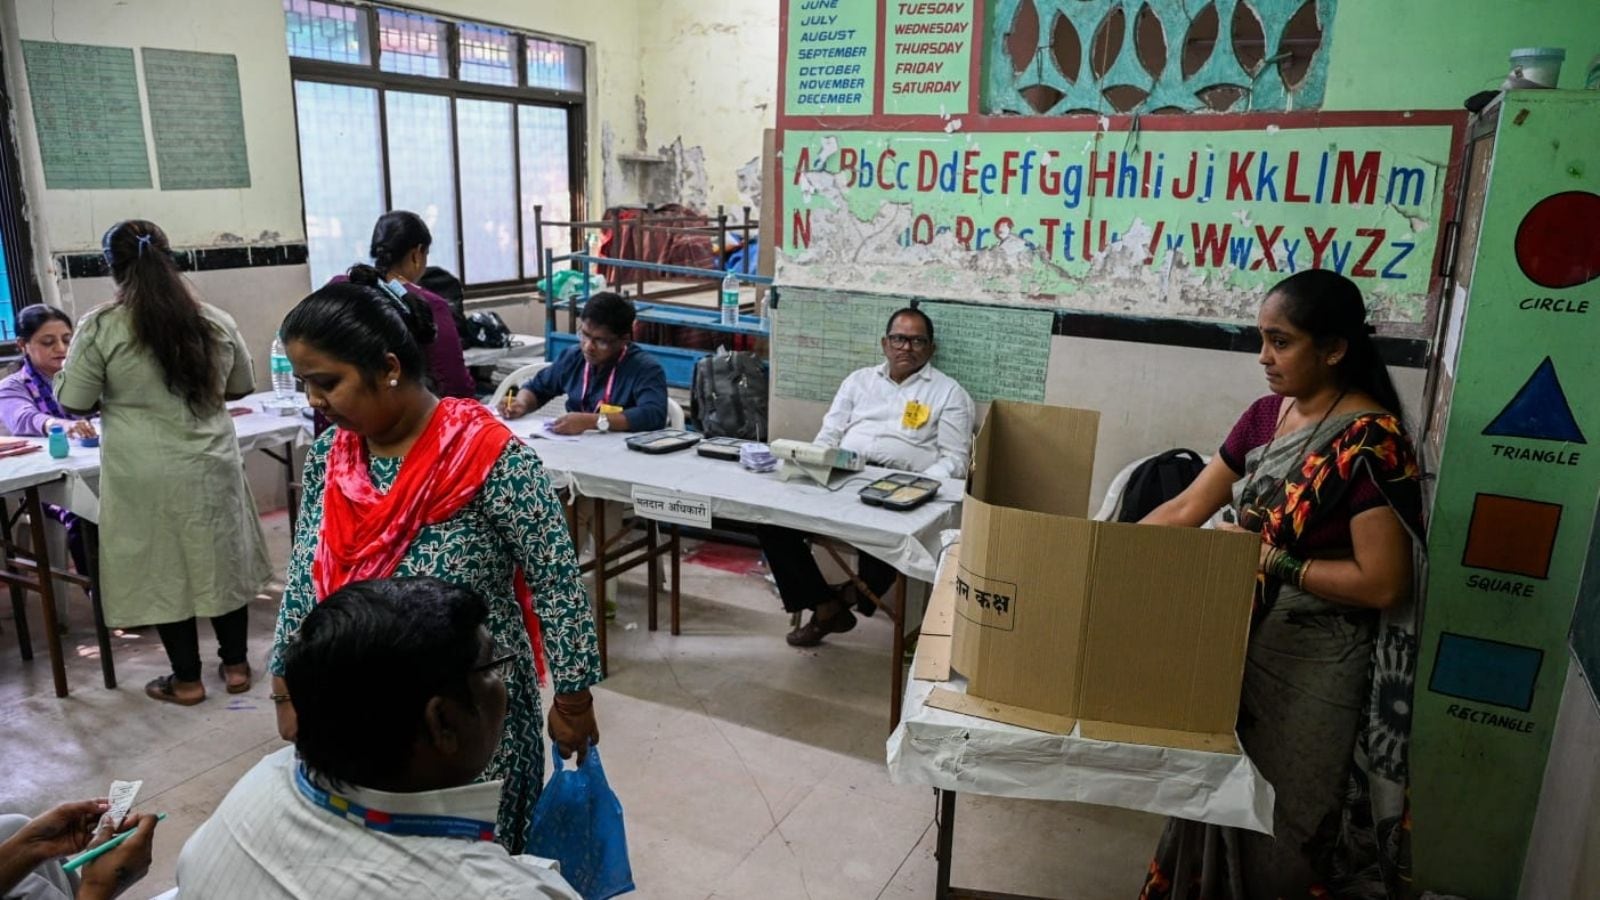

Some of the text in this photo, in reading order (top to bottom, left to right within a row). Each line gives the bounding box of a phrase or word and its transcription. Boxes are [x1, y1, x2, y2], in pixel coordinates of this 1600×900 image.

[801, 0, 838, 10] JUNE
[899, 3, 964, 15] TUESDAY
[801, 15, 838, 26] JULY
[895, 22, 969, 35] WEDNESDAY
[801, 30, 856, 42] AUGUST
[798, 47, 867, 60] SEPTEMBER
[895, 42, 964, 55] THURSDAY
[800, 65, 861, 76] OCTOBER
[895, 62, 944, 75] FRIDAY
[800, 79, 865, 90] NOVEMBER
[892, 81, 961, 94] SATURDAY
[797, 93, 862, 105] DECEMBER
[1519, 298, 1590, 314] CIRCLE
[1491, 444, 1581, 466] TRIANGLE
[668, 500, 707, 518] अधिकारी
[1466, 574, 1535, 598] SQUARE
[973, 588, 1010, 616] कक्ष
[1446, 704, 1535, 734] RECTANGLE
